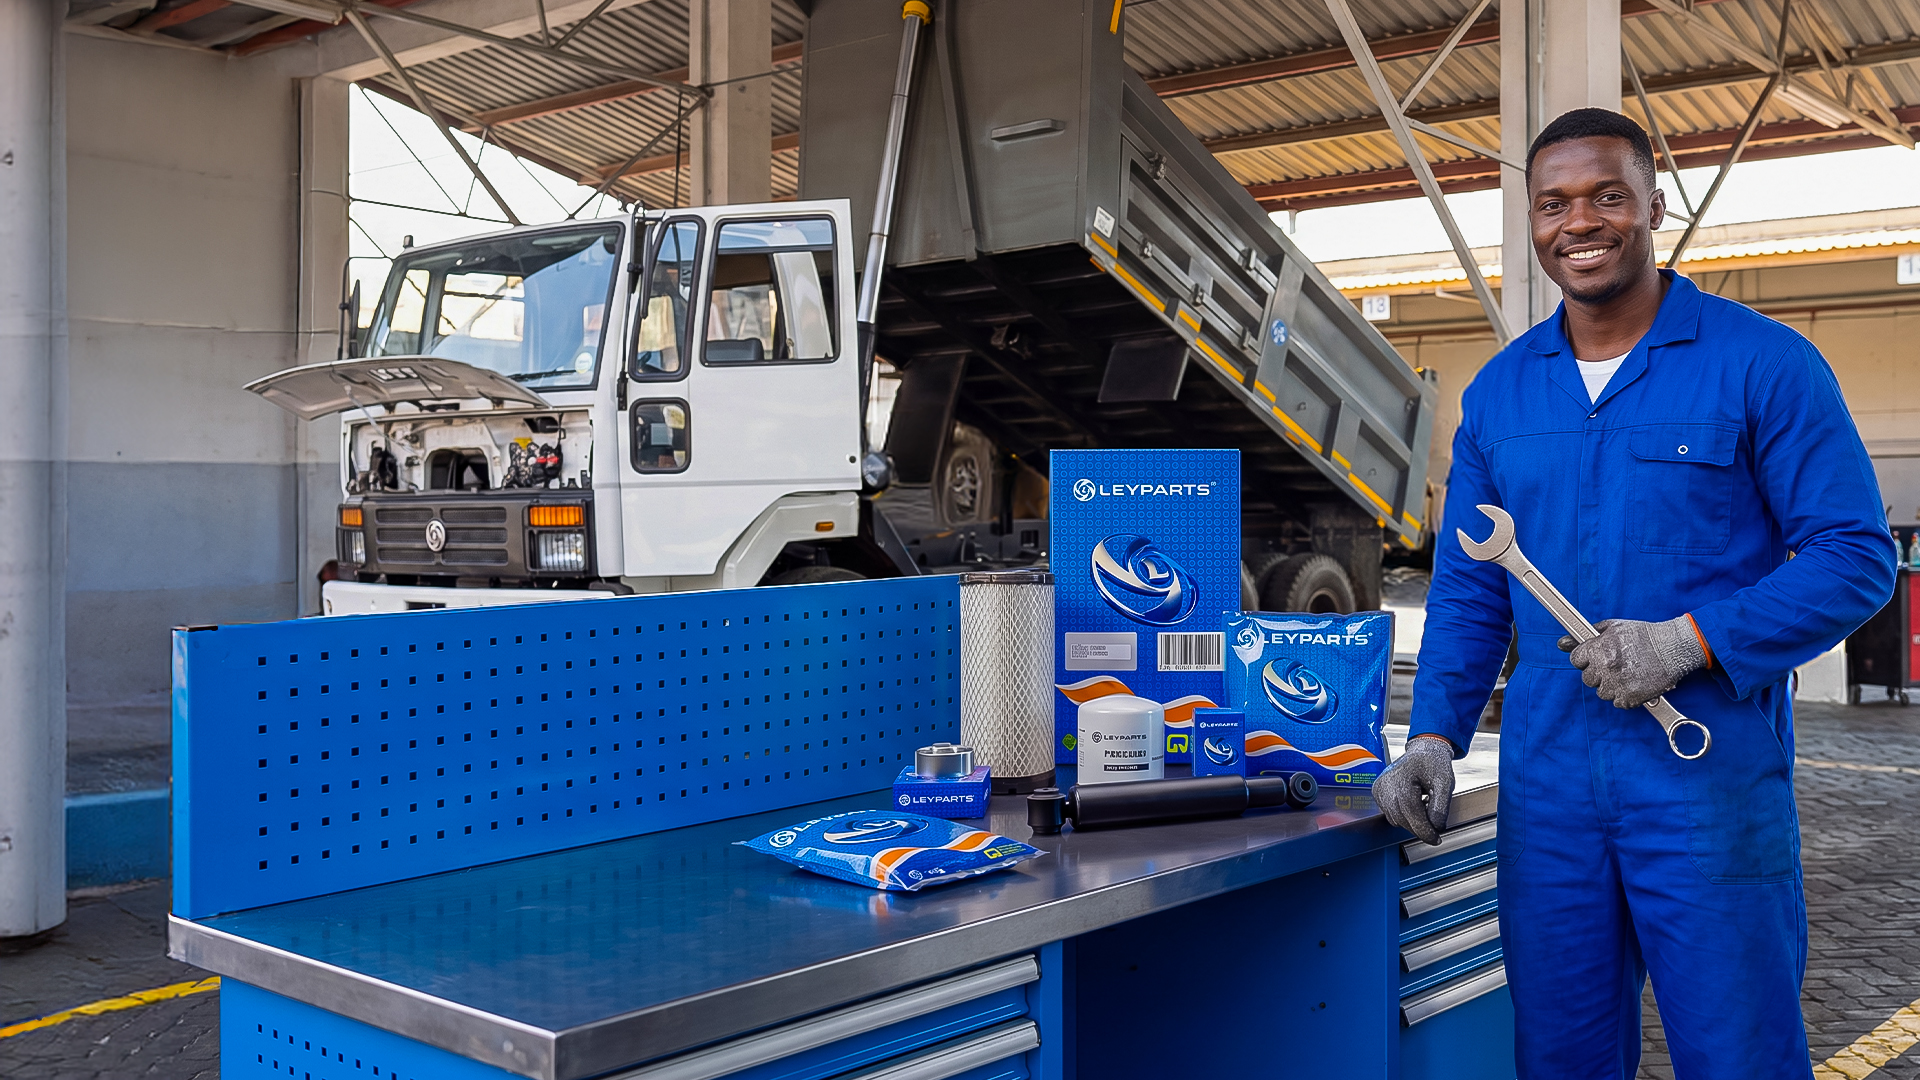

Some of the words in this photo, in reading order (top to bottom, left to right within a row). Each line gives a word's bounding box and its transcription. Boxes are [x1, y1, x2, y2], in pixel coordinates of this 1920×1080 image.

[1904, 257, 1920, 275] 1
[1099, 484, 1210, 496] LEYPARTS
[912, 795, 974, 804] LEYPARTS
